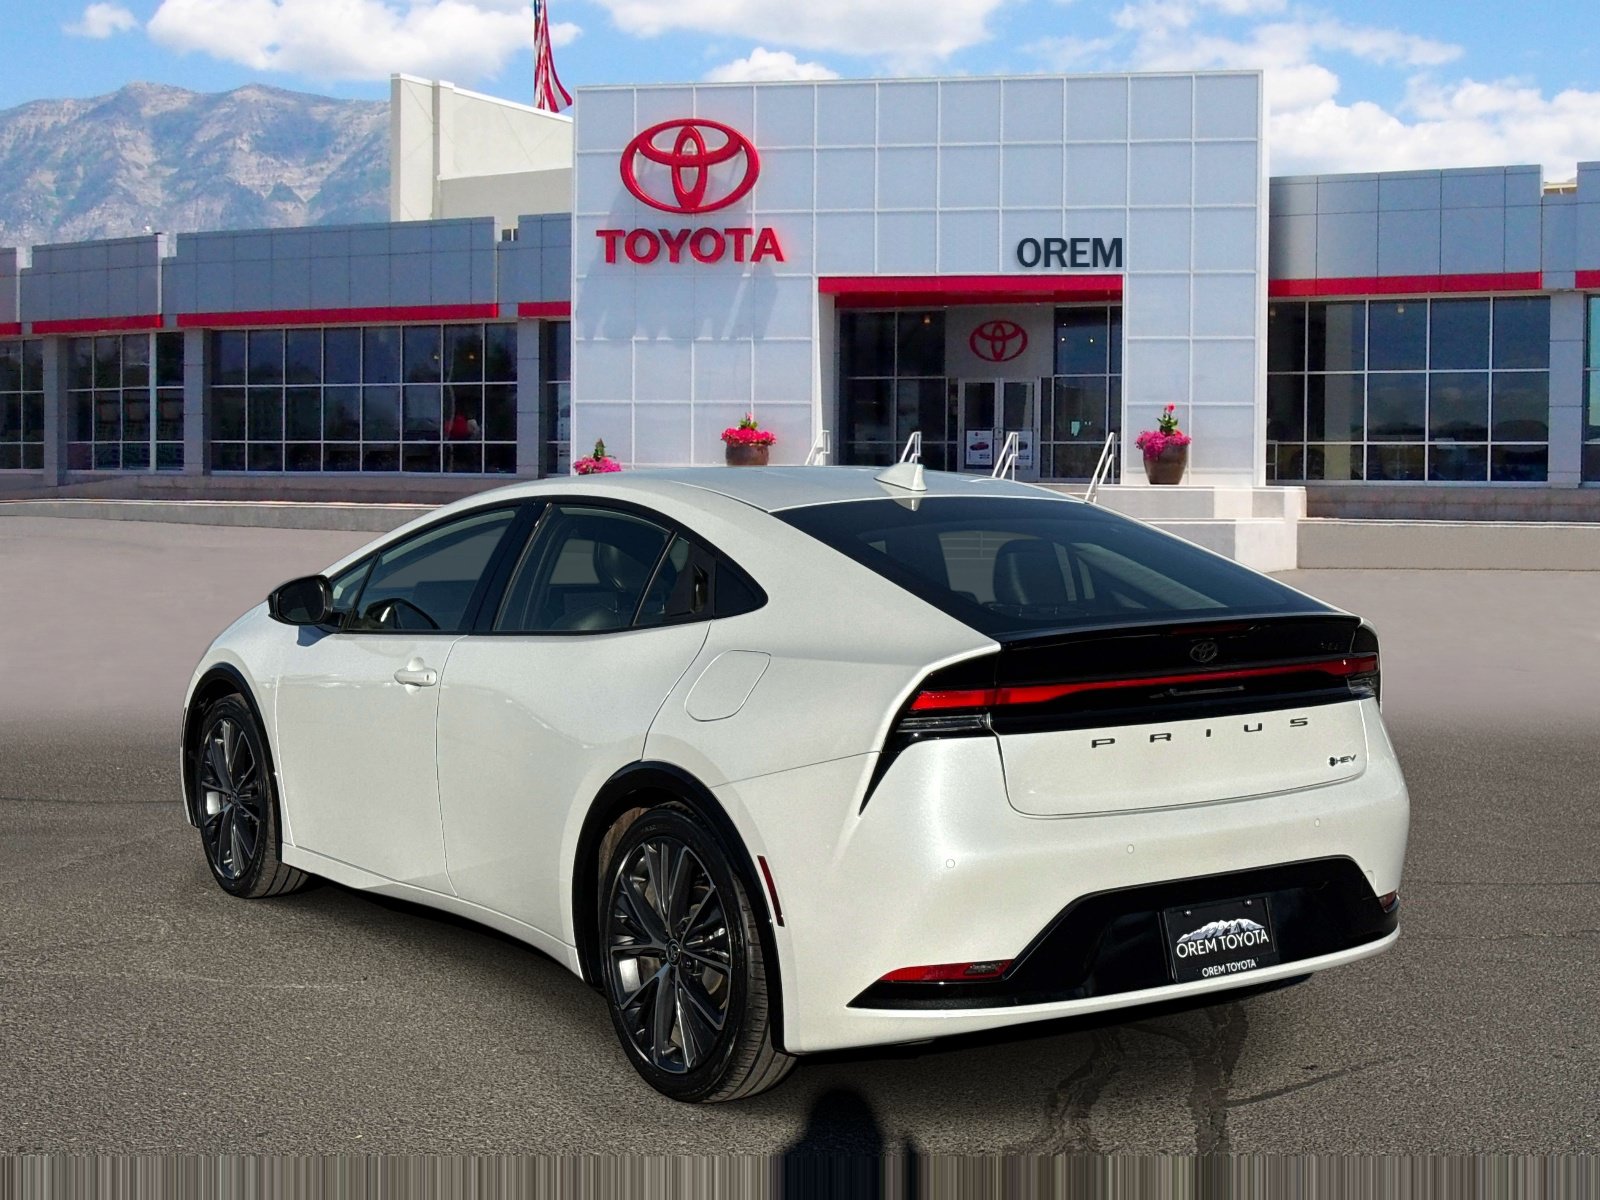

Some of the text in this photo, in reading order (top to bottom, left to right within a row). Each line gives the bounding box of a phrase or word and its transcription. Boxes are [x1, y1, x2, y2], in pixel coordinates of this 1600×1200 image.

[596, 227, 785, 264] TOYOTA
[1017, 237, 1123, 268] OREM
[1091, 717, 1308, 748] PRIUS
[1335, 754, 1357, 764] HEV
[1176, 930, 1270, 958] OREM TOYOTA
[1202, 959, 1257, 977] OREM TOYOTA
